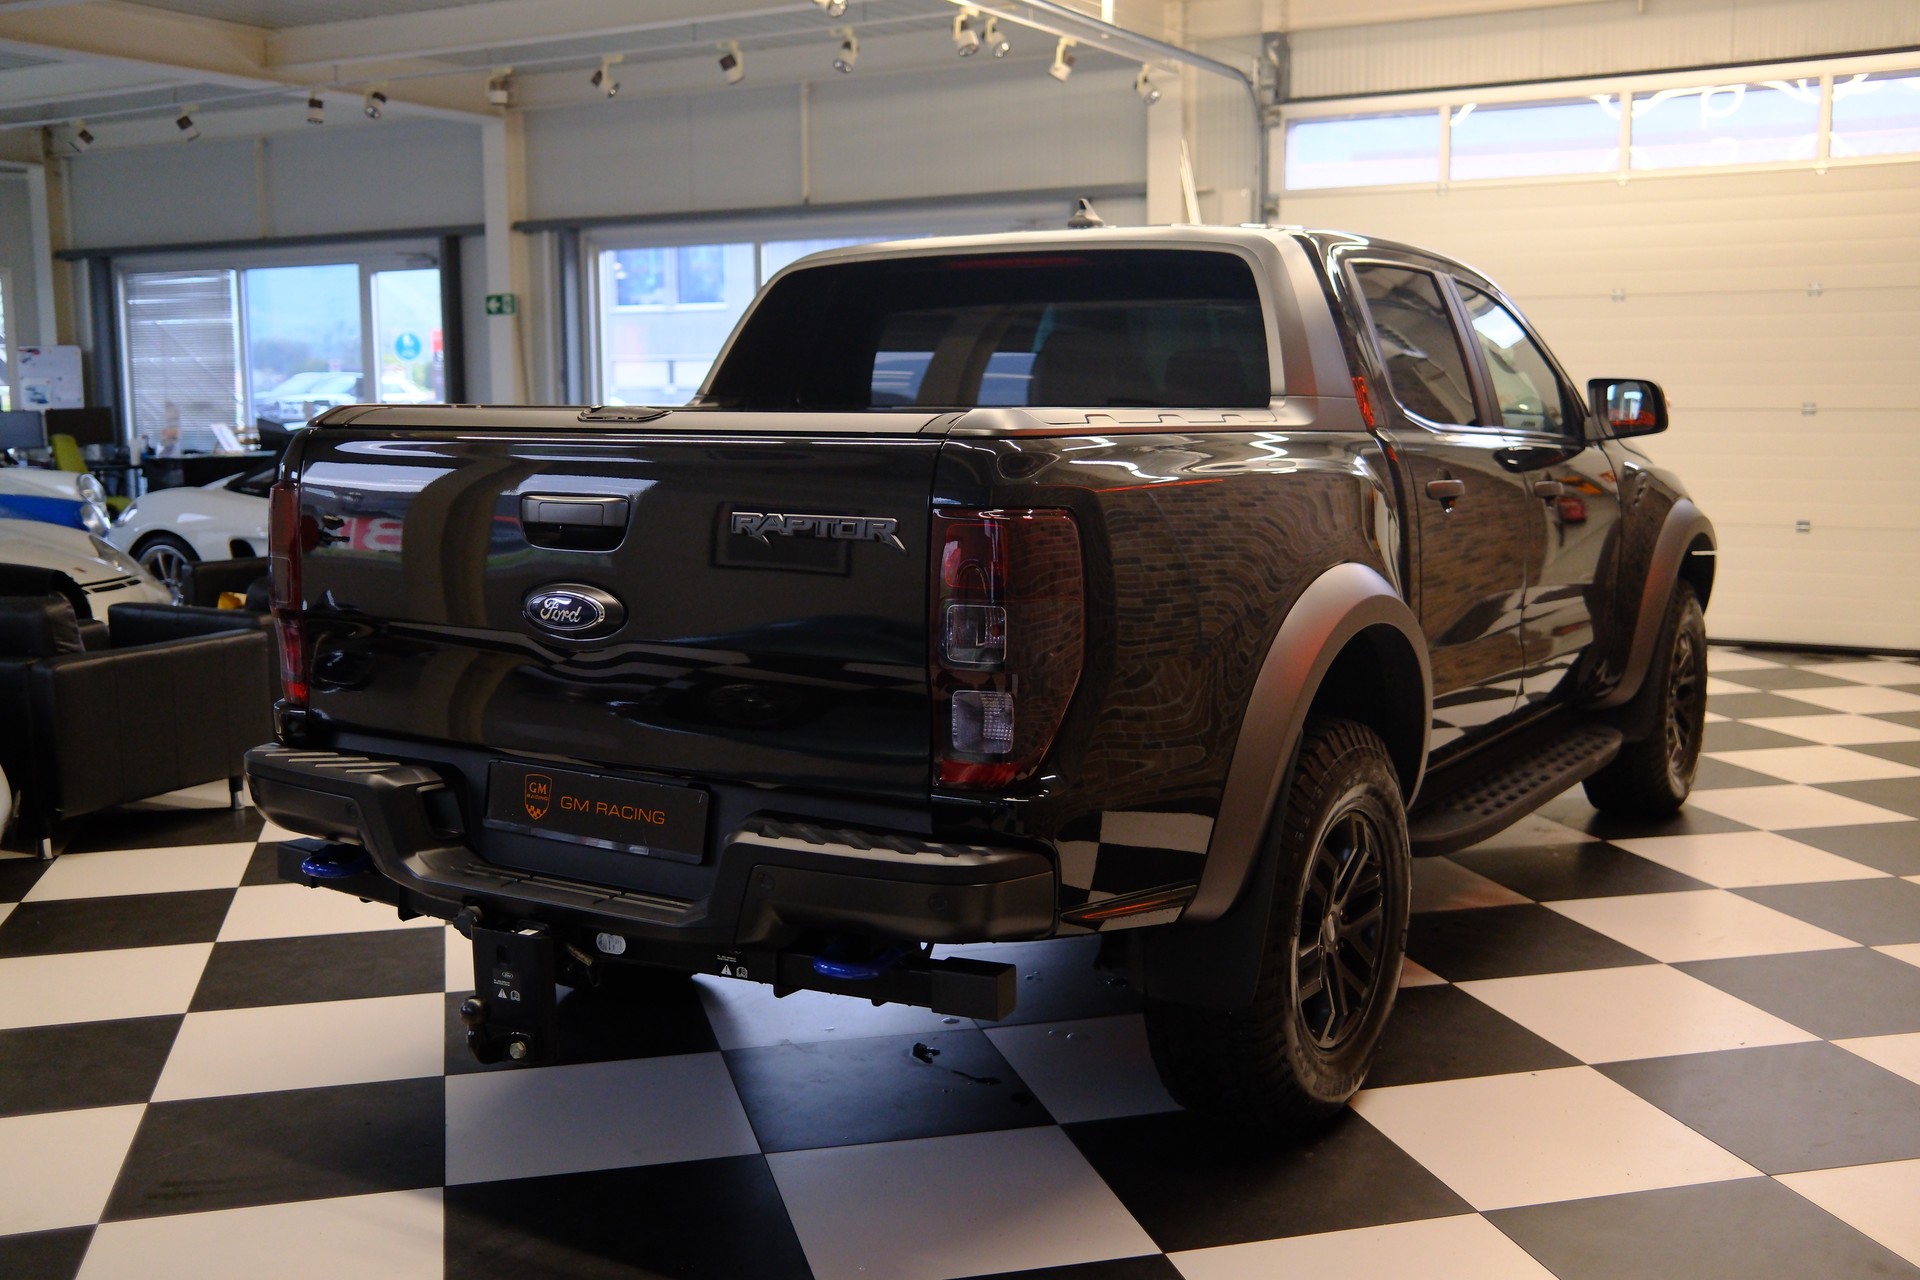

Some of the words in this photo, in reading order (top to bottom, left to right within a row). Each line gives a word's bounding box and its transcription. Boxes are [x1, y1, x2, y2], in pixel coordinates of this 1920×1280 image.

[731, 511, 907, 552] RAPTOR
[540, 597, 582, 622] Ford
[529, 782, 547, 795] GM
[560, 796, 589, 813] GM
[596, 801, 665, 825] RACING
